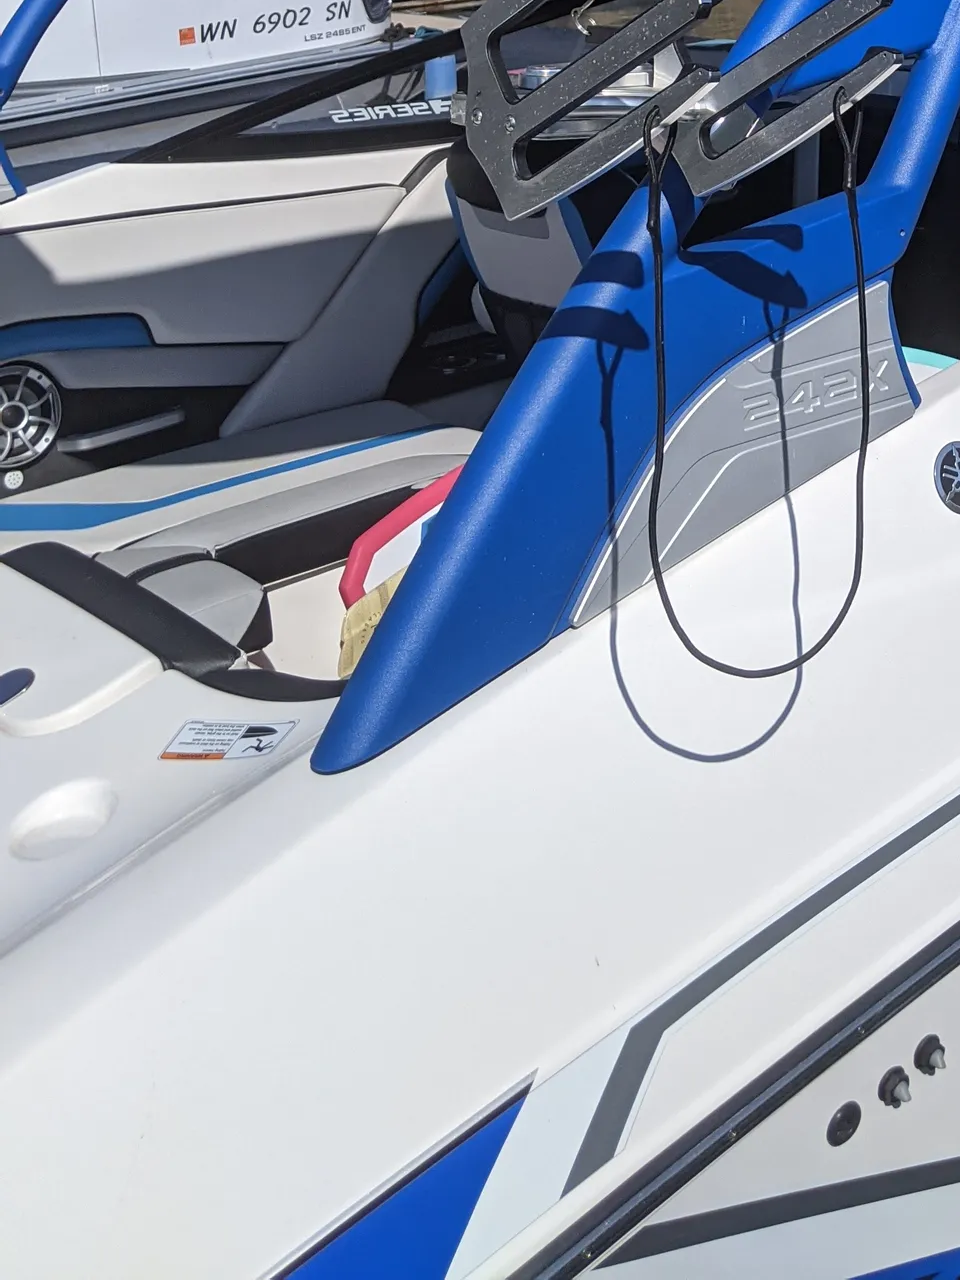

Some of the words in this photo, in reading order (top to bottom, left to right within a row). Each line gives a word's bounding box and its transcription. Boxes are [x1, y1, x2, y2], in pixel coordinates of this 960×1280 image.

[200, 18, 238, 44] WN
[252, 6, 311, 34] 6902
[325, 0, 352, 22] SN
[351, 24, 367, 34] ENT
[742, 358, 889, 432] 242X
